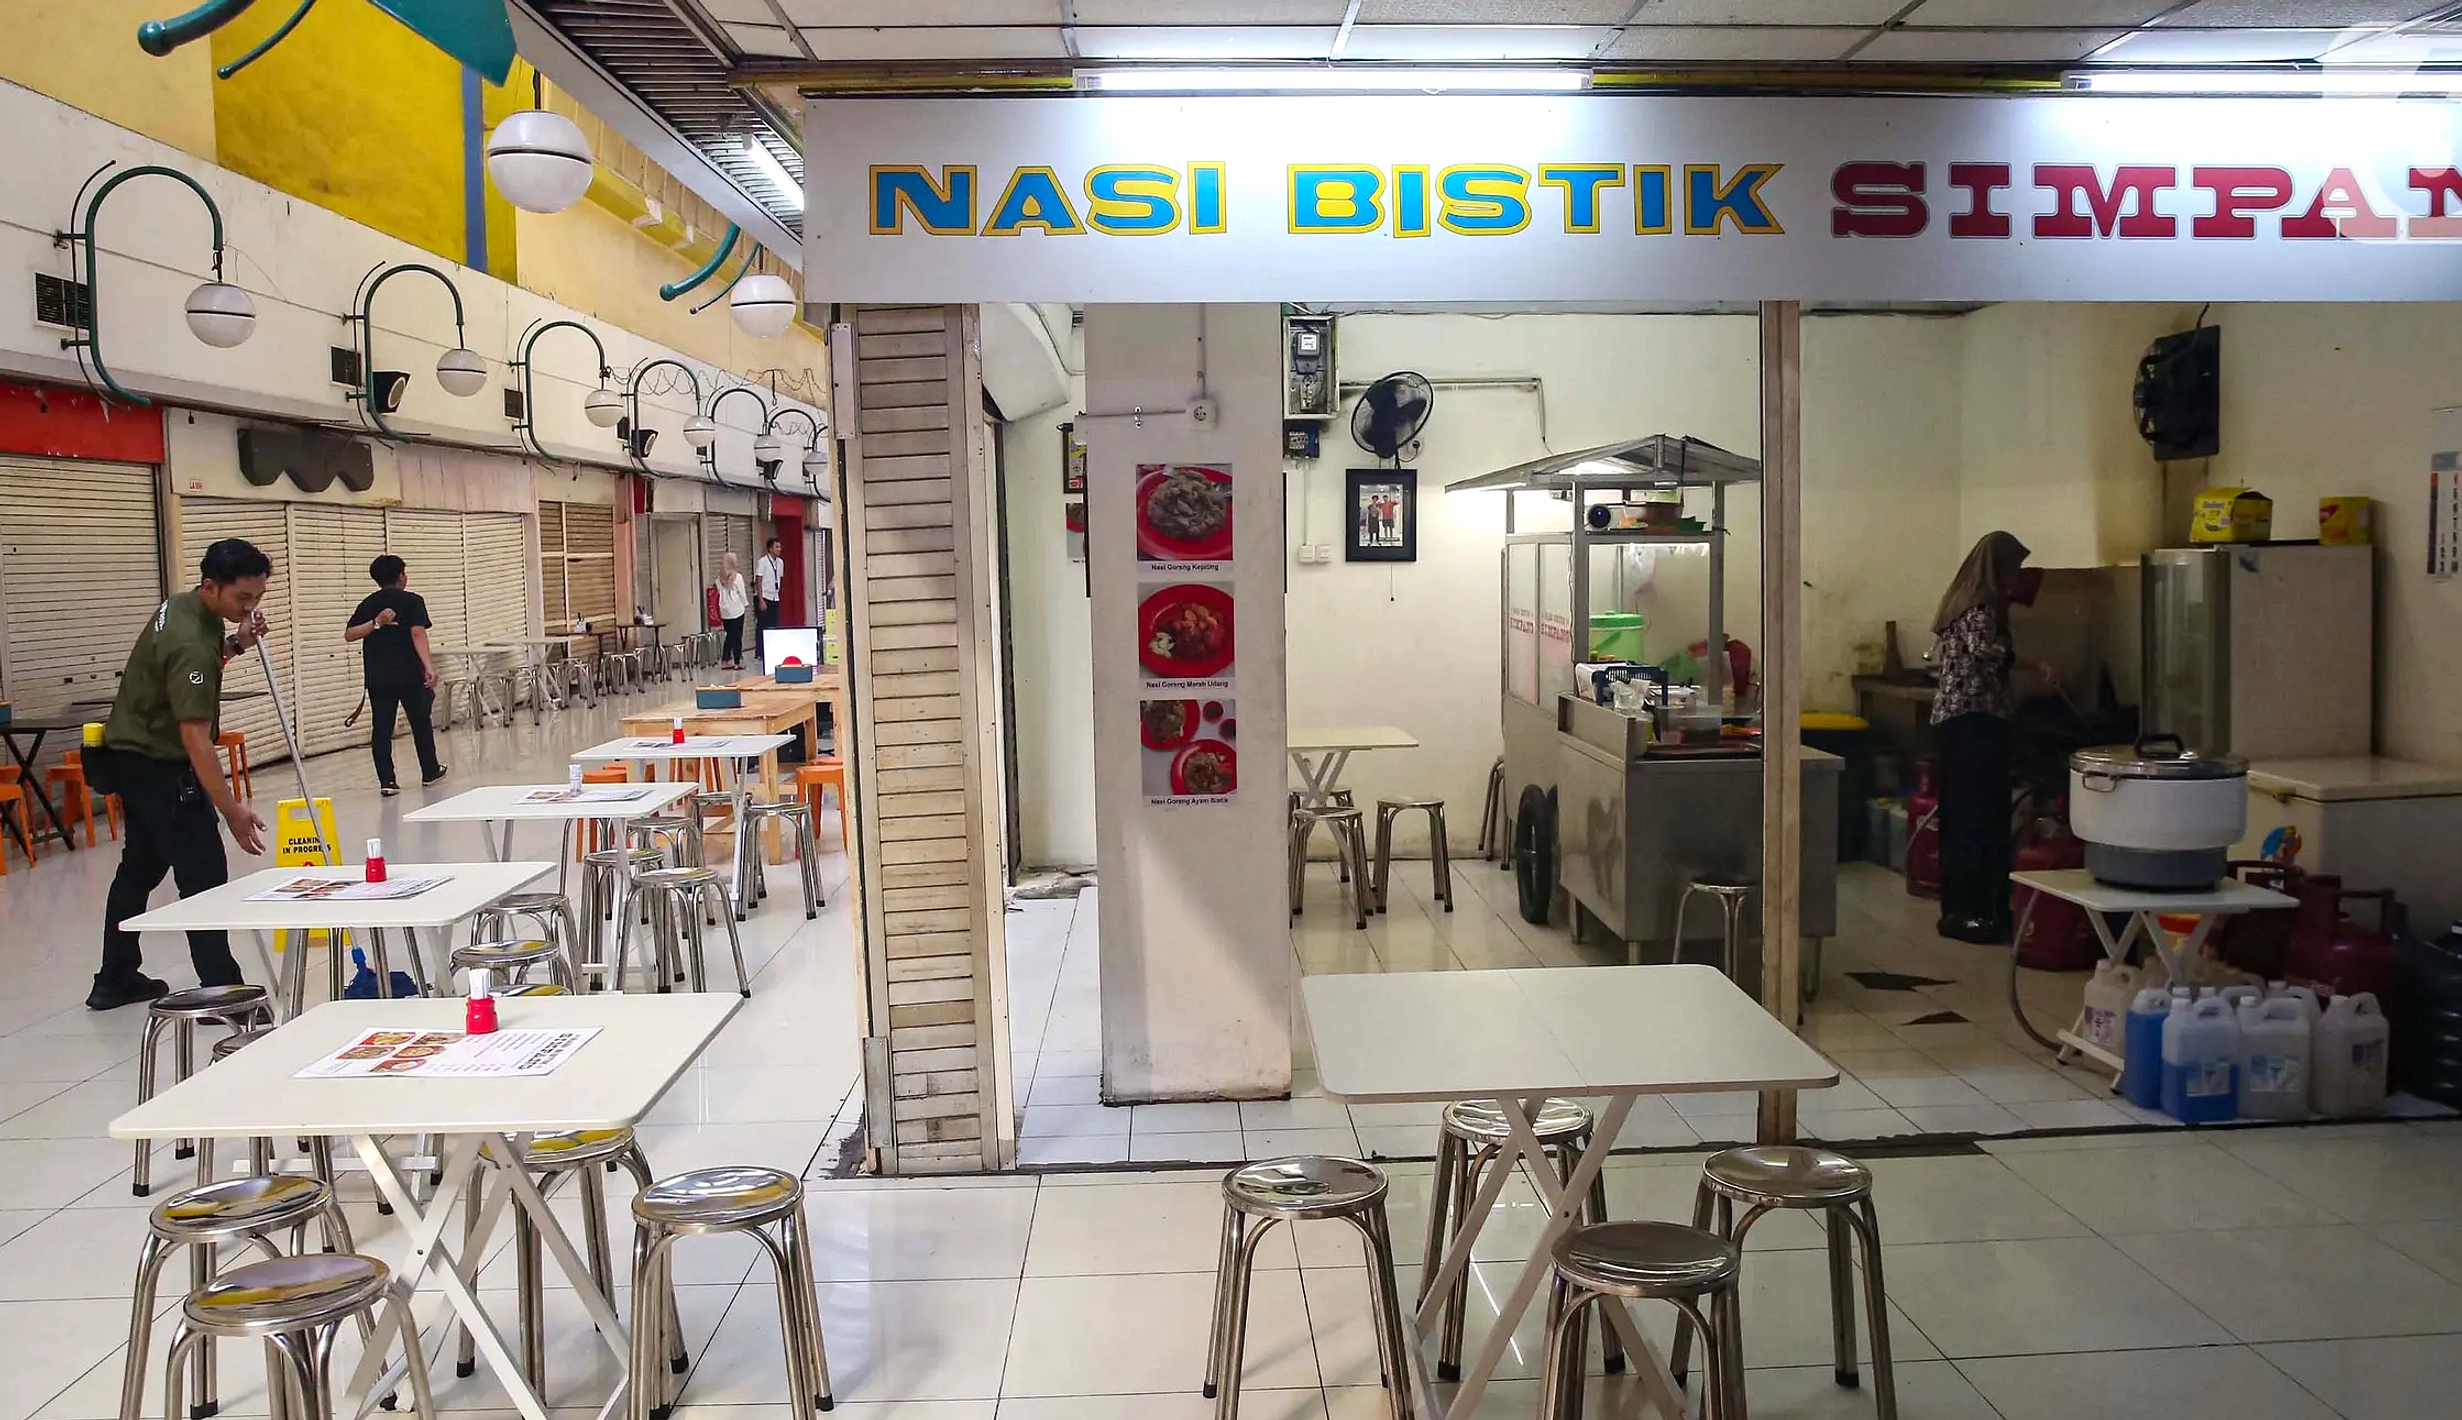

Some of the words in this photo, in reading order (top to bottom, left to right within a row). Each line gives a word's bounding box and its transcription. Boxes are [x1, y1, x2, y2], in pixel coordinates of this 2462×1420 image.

[869, 161, 1227, 236] NASI
[1287, 162, 1786, 238] BISTIK
[1167, 563, 1191, 571] Goreng
[1207, 680, 1229, 688] Udang
[1166, 798, 1190, 806] Goreng
[288, 837, 321, 845] CLEANIN
[293, 844, 332, 853] PROGRES
